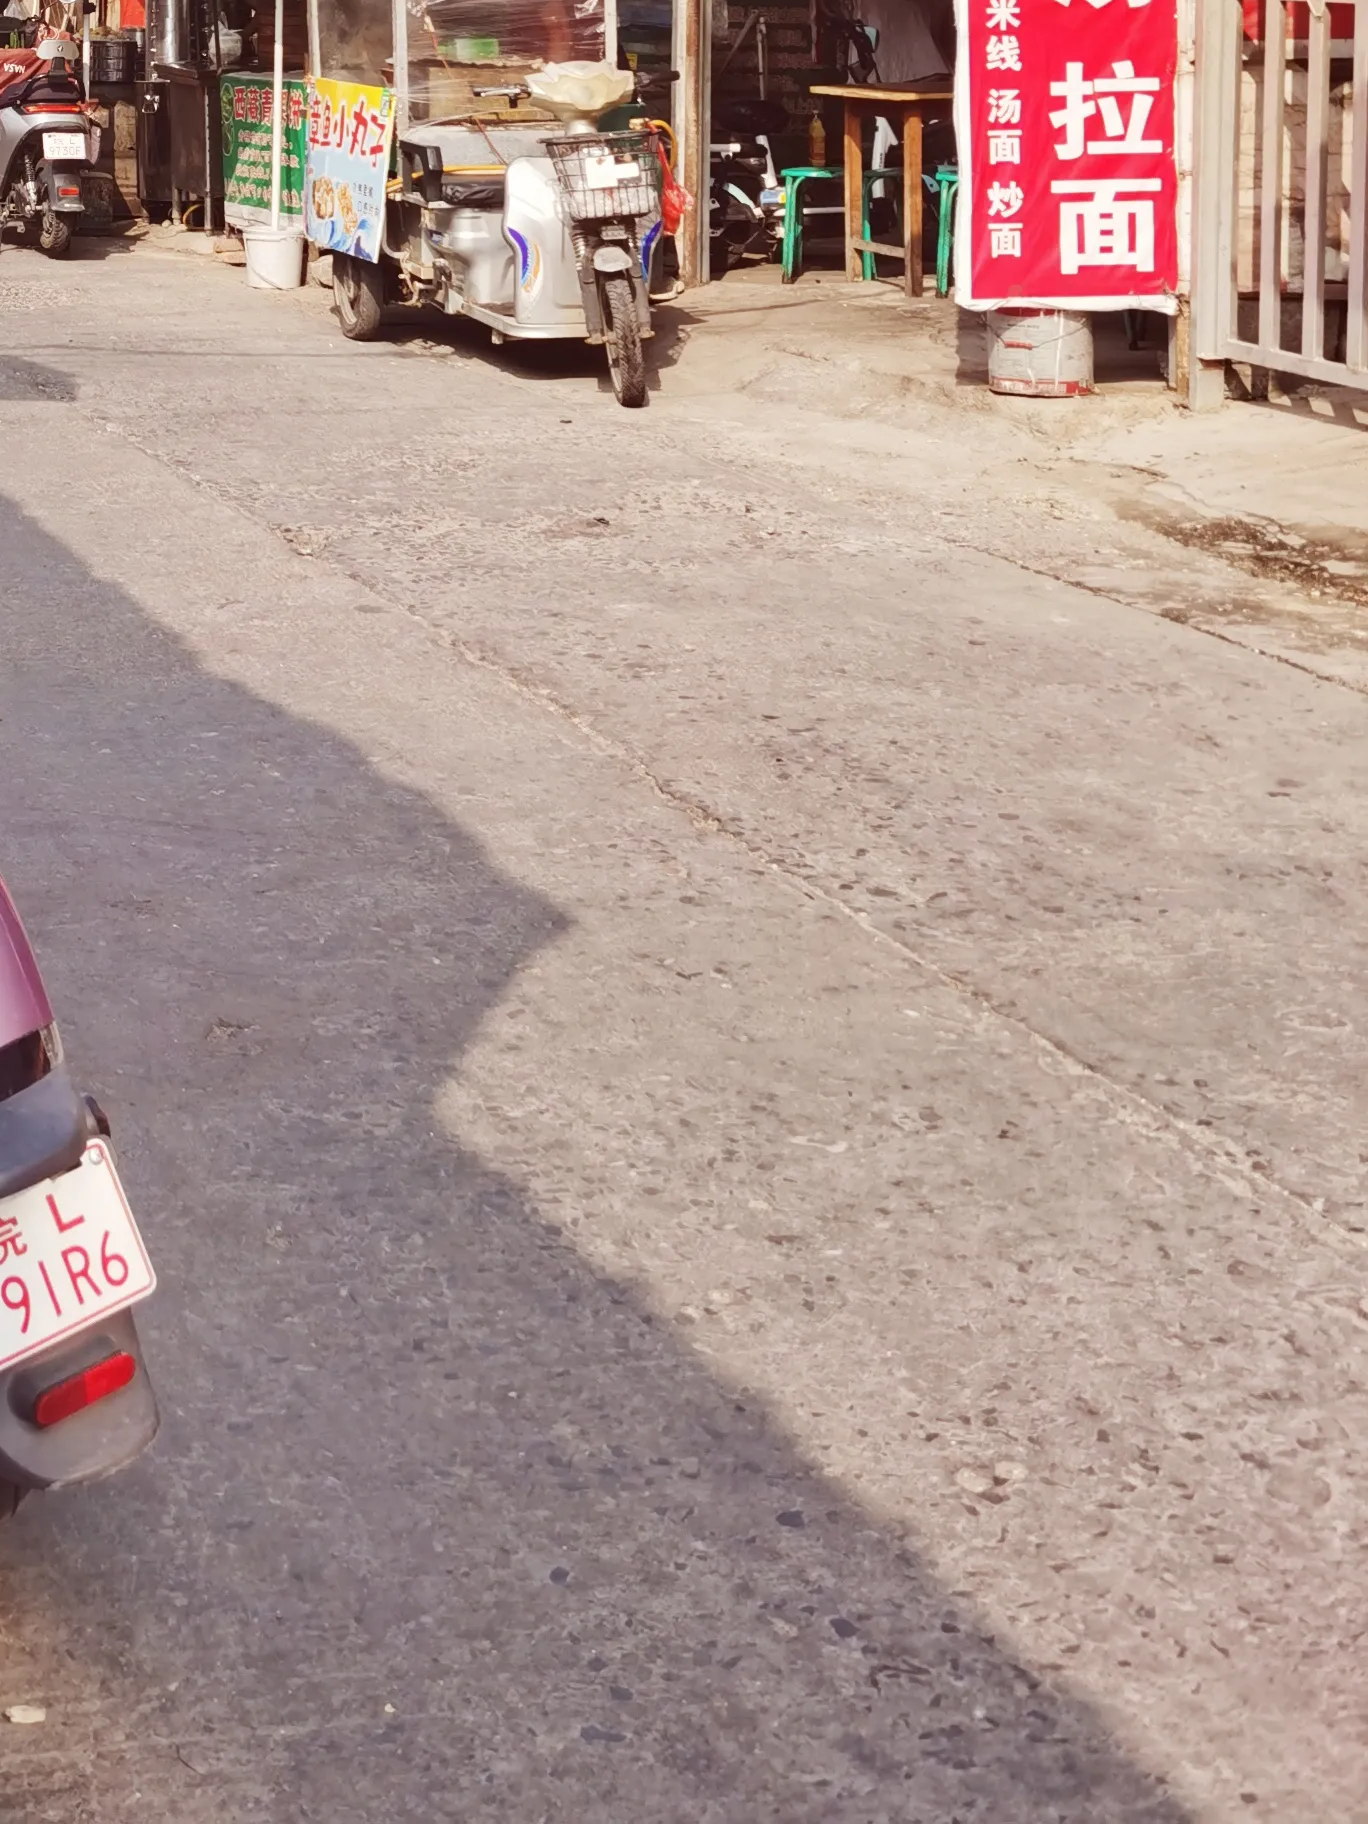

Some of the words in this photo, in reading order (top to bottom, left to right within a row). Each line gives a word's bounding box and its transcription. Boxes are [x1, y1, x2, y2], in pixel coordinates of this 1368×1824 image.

[3, 62, 26, 74] NASA
[309, 97, 386, 168] 章鱼小丸子
[987, 88, 1023, 166] 汤面
[1049, 60, 1164, 275] 拉面
[988, 180, 1025, 259] 炒面
[45, 1193, 86, 1233] L
